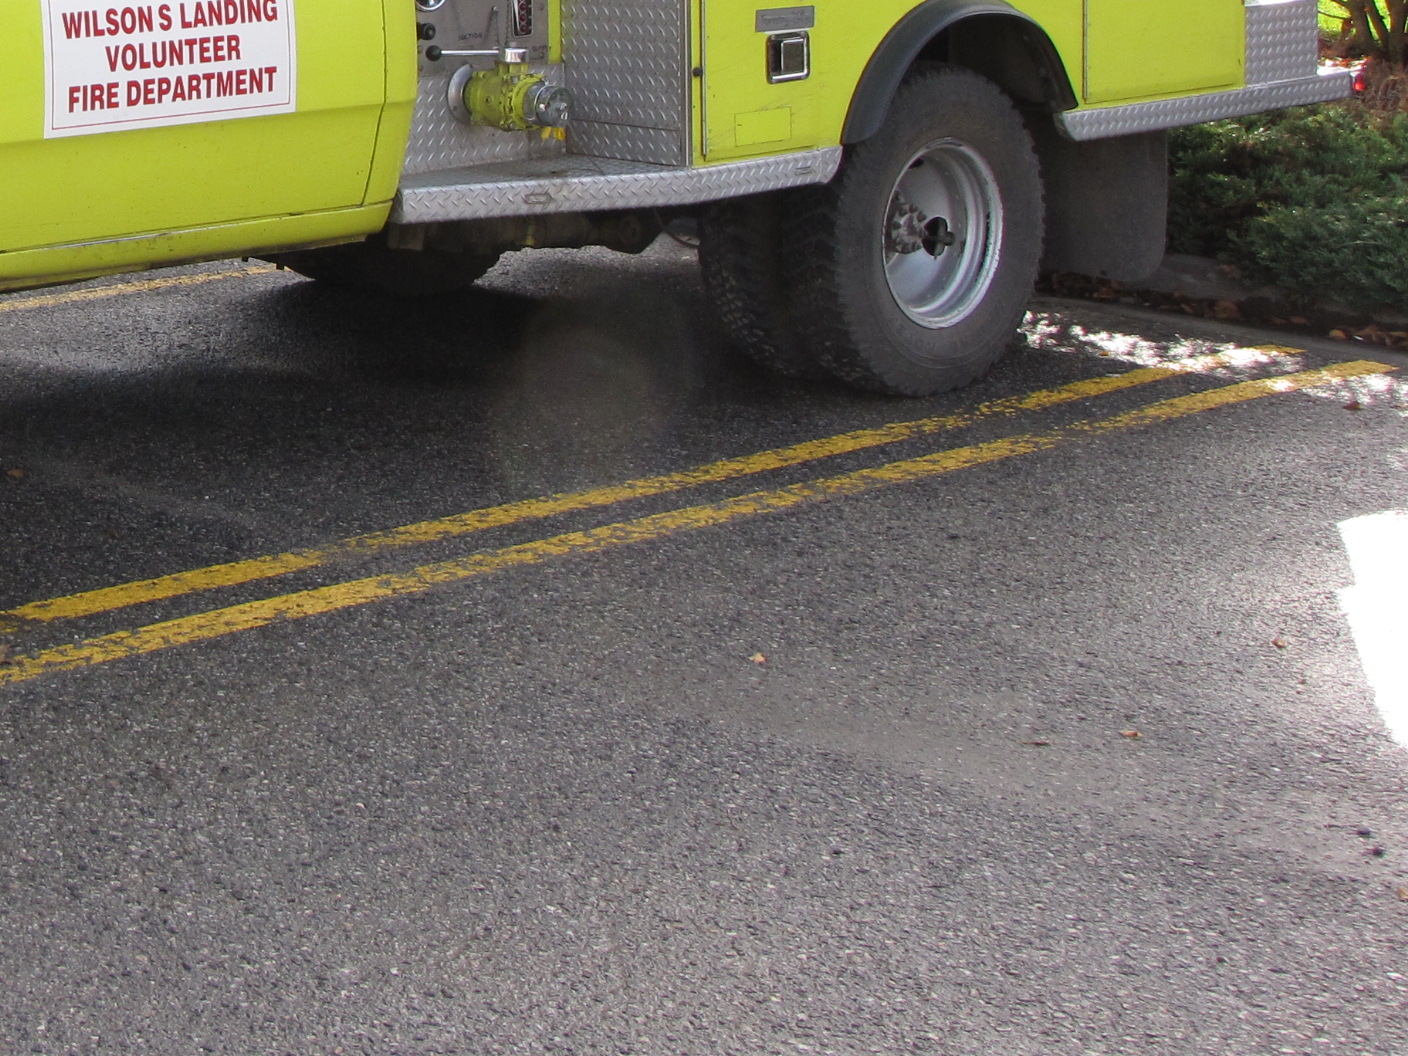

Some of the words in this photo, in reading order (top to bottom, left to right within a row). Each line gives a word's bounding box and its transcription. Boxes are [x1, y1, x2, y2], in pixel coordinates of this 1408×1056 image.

[105, 34, 241, 72] VOLUNTEER
[68, 82, 119, 113] FIRE
[127, 66, 277, 107] DEPARTMENT
